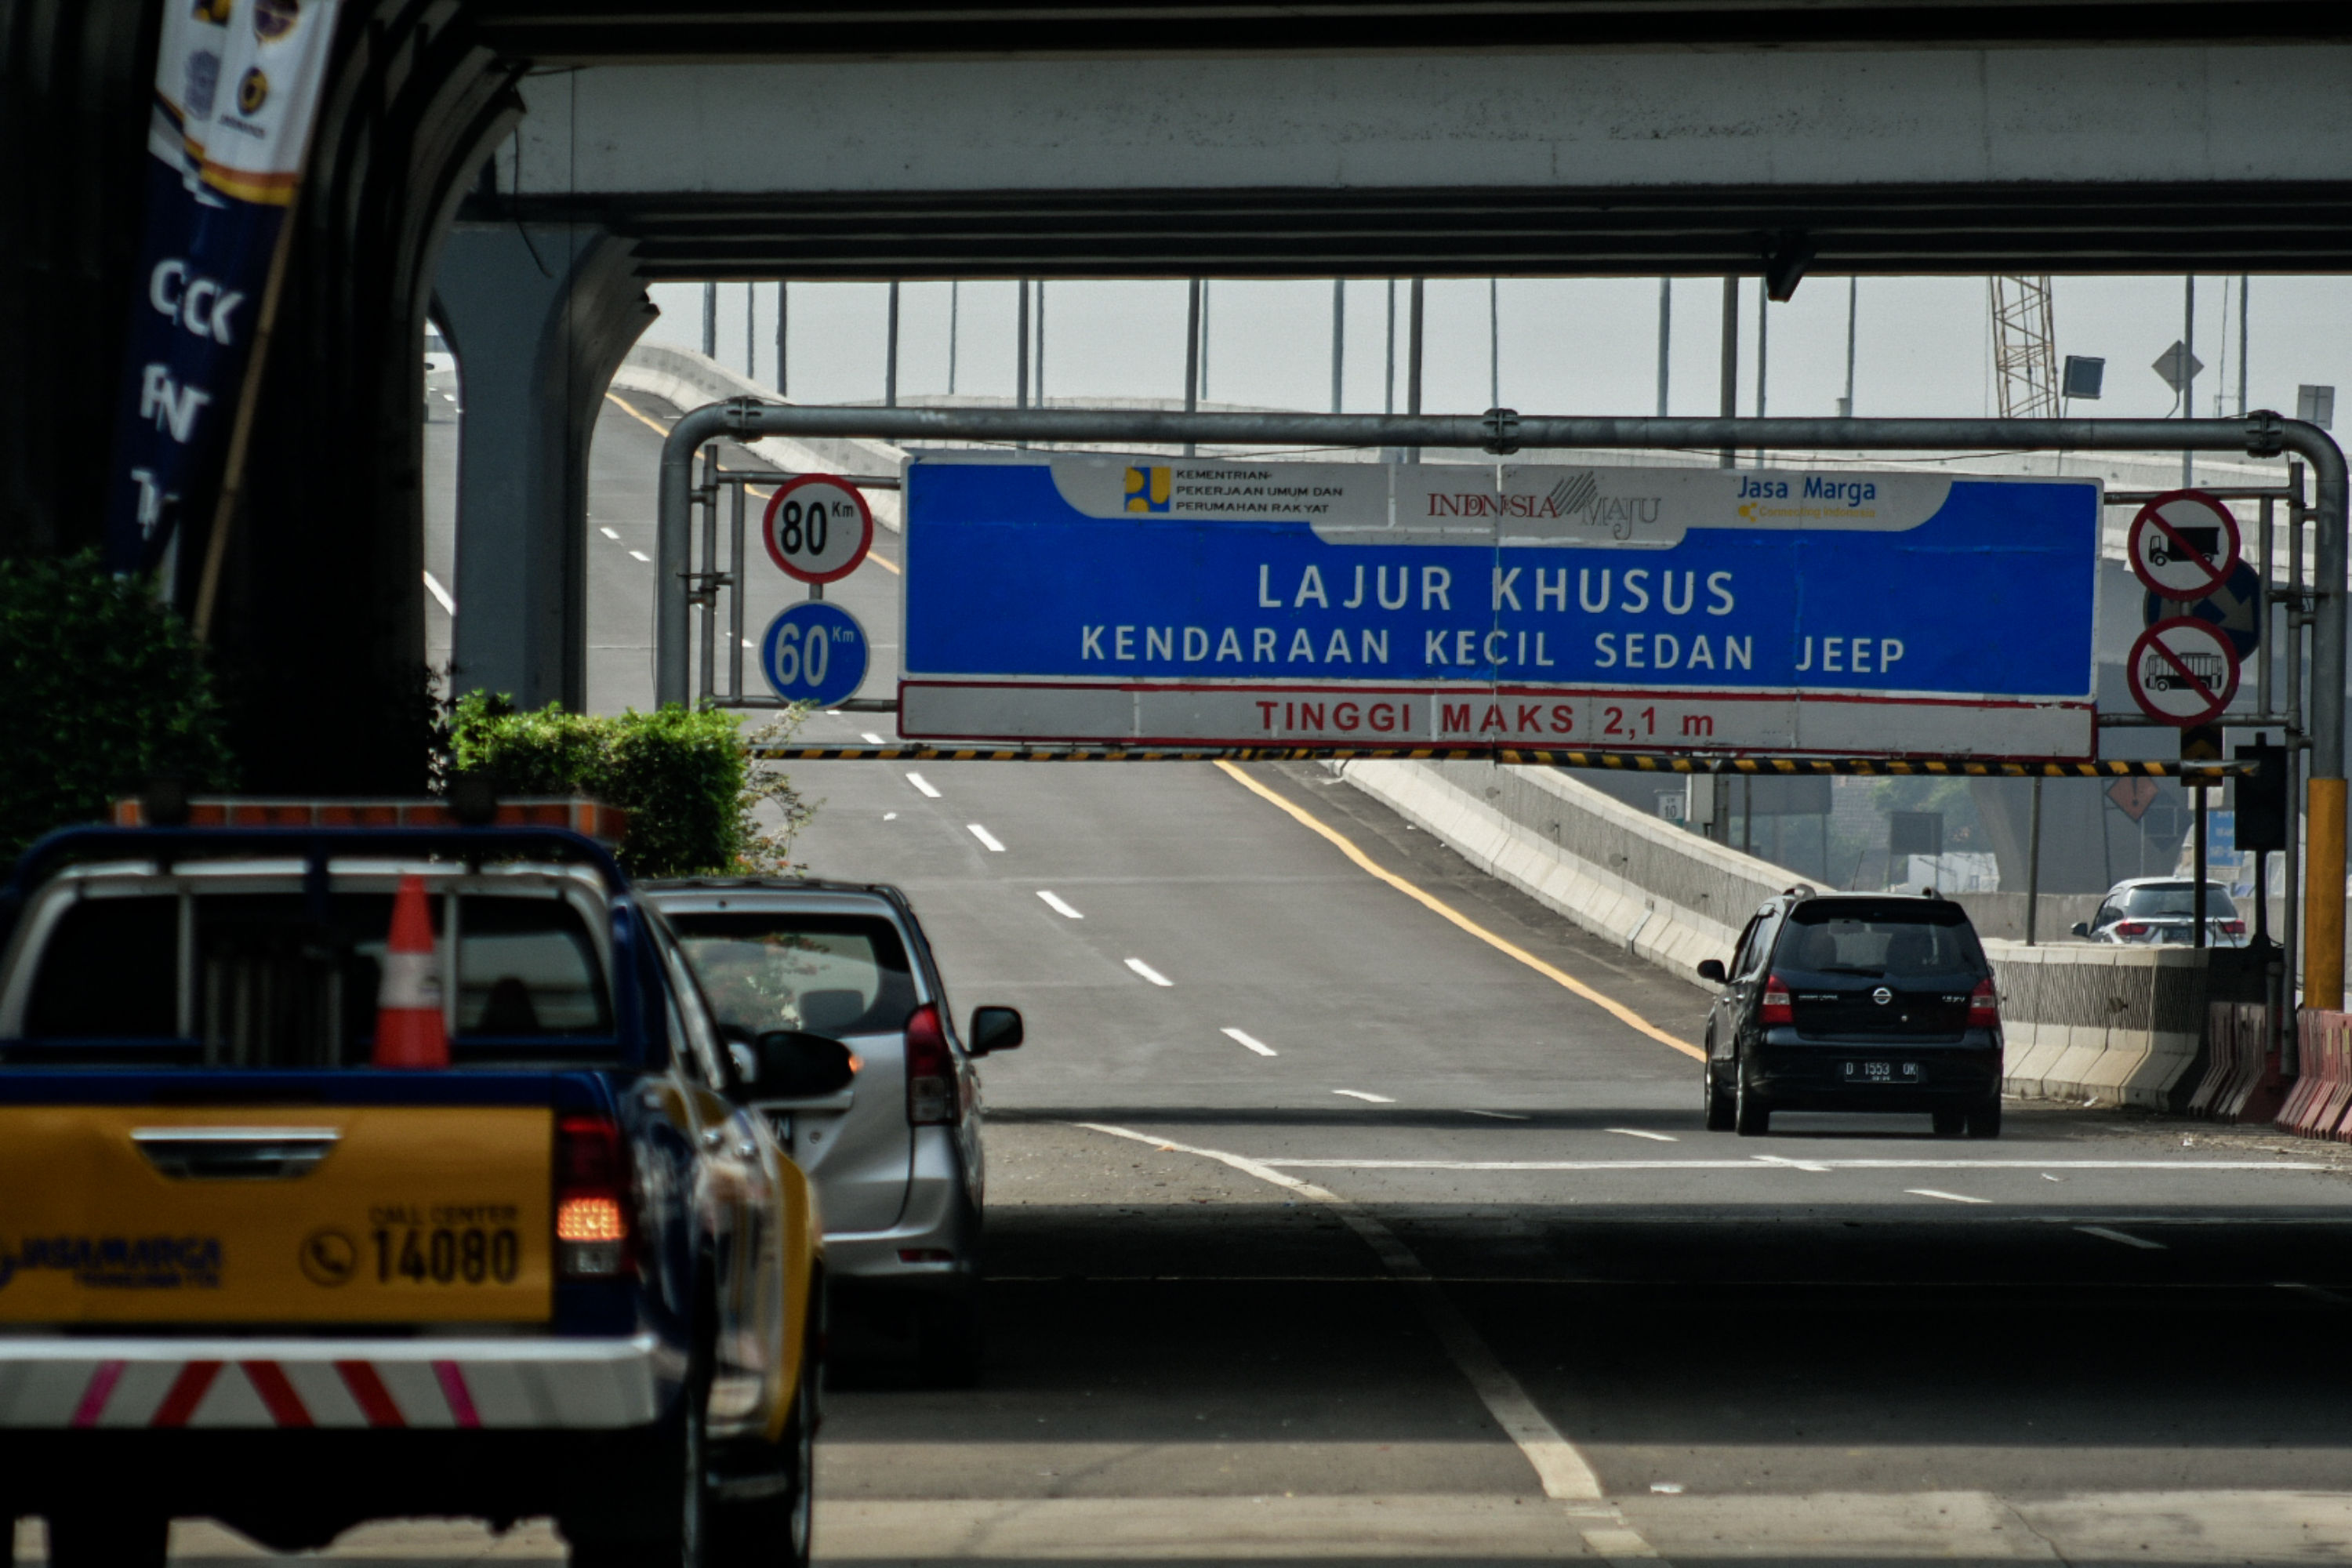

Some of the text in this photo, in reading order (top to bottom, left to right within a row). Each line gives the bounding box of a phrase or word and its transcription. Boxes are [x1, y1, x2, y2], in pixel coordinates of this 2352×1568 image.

[1175, 502, 1330, 514] PERUMAHAN RAKYAT
[1176, 485, 1343, 496] PEKERJAAN UMUM DAN
[1737, 475, 1876, 507] Jasa Marga
[780, 500, 854, 556] 80 Km
[1258, 564, 1736, 616] LAJUR KHUSUS
[775, 622, 855, 688] 60 Km
[1081, 625, 1904, 673] KENDARAAN KECIL SEDAN JEEP
[1255, 701, 1715, 740] TINGGI MAKS 2,1 m
[371, 1228, 518, 1284] 14080
